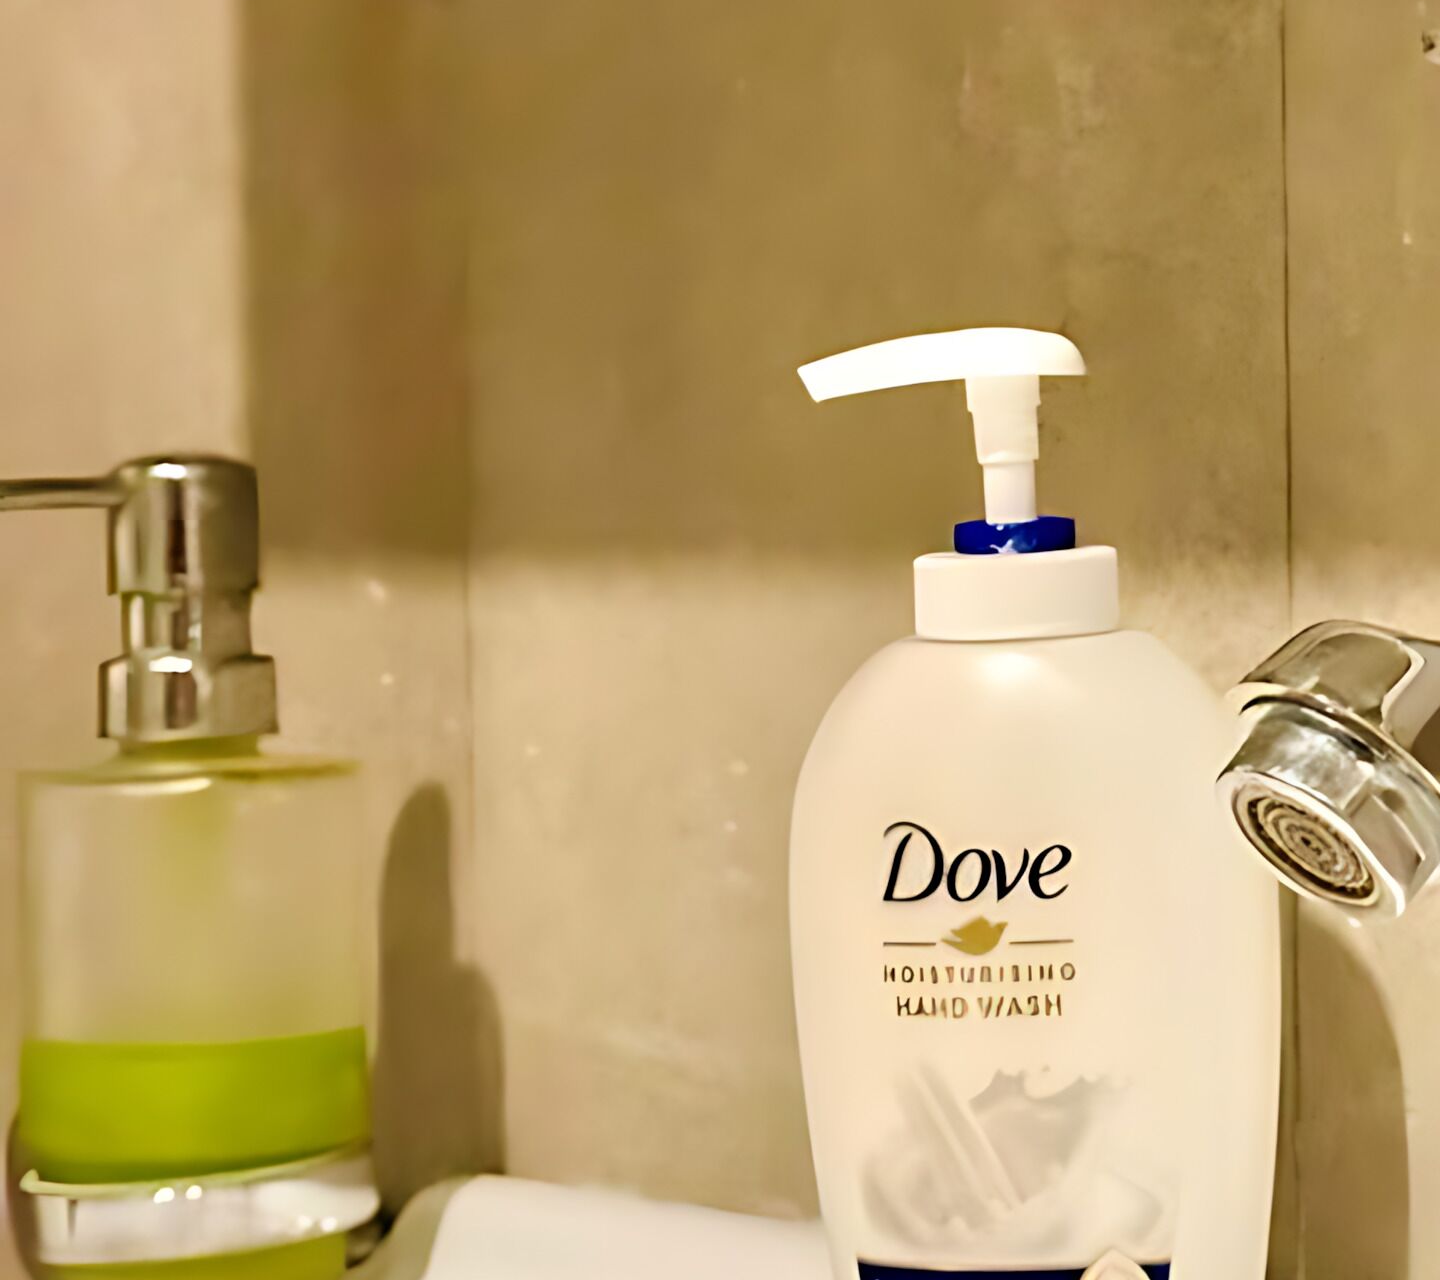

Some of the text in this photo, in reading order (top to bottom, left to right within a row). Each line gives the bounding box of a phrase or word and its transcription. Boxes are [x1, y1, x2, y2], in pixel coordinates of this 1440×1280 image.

[882, 821, 1073, 902] Dove
[896, 993, 1063, 1019] HAND WASH
